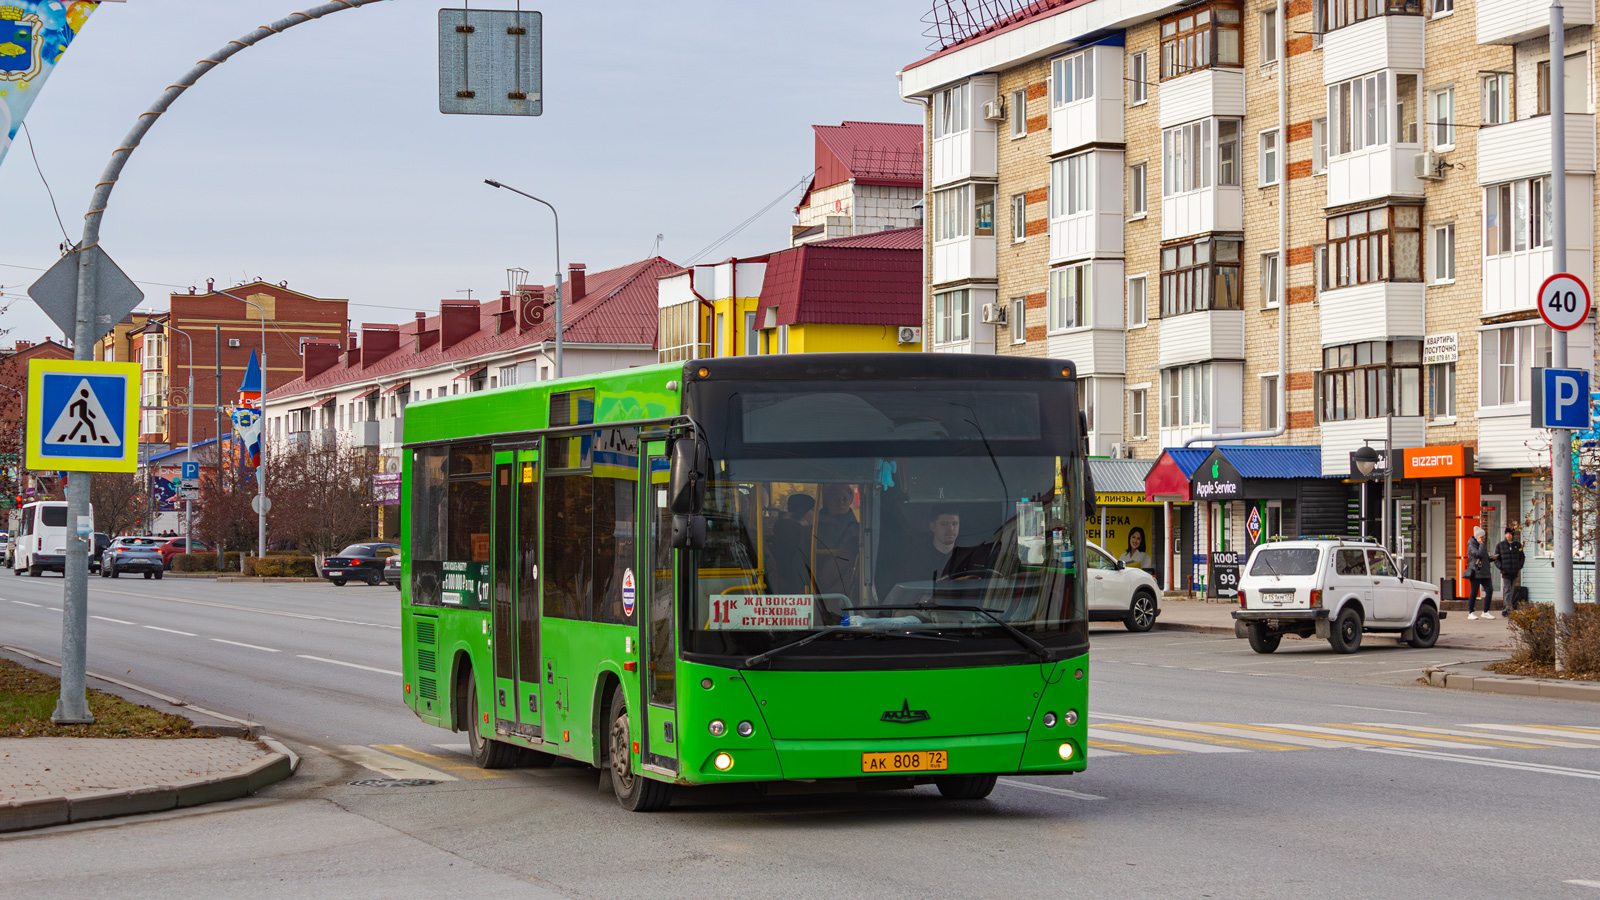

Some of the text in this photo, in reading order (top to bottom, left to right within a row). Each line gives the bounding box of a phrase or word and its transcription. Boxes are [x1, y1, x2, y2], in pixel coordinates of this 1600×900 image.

[1548, 290, 1576, 312] 40
[1427, 336, 1454, 345] КВАРТИРЫ
[1424, 344, 1456, 354] ПОСУТОЧНО
[1556, 376, 1579, 420] P
[186, 464, 196, 477] P
[1197, 480, 1236, 498] Apple Service
[1214, 553, 1238, 564] КОФЕ
[766, 597, 811, 606] ВОКЗАЛ
[754, 607, 797, 616] ЧЕХОВА
[742, 617, 809, 626] СТРЕХНИНО
[870, 758, 886, 769] АК
[894, 754, 920, 768] 808
[929, 752, 942, 763] 72
